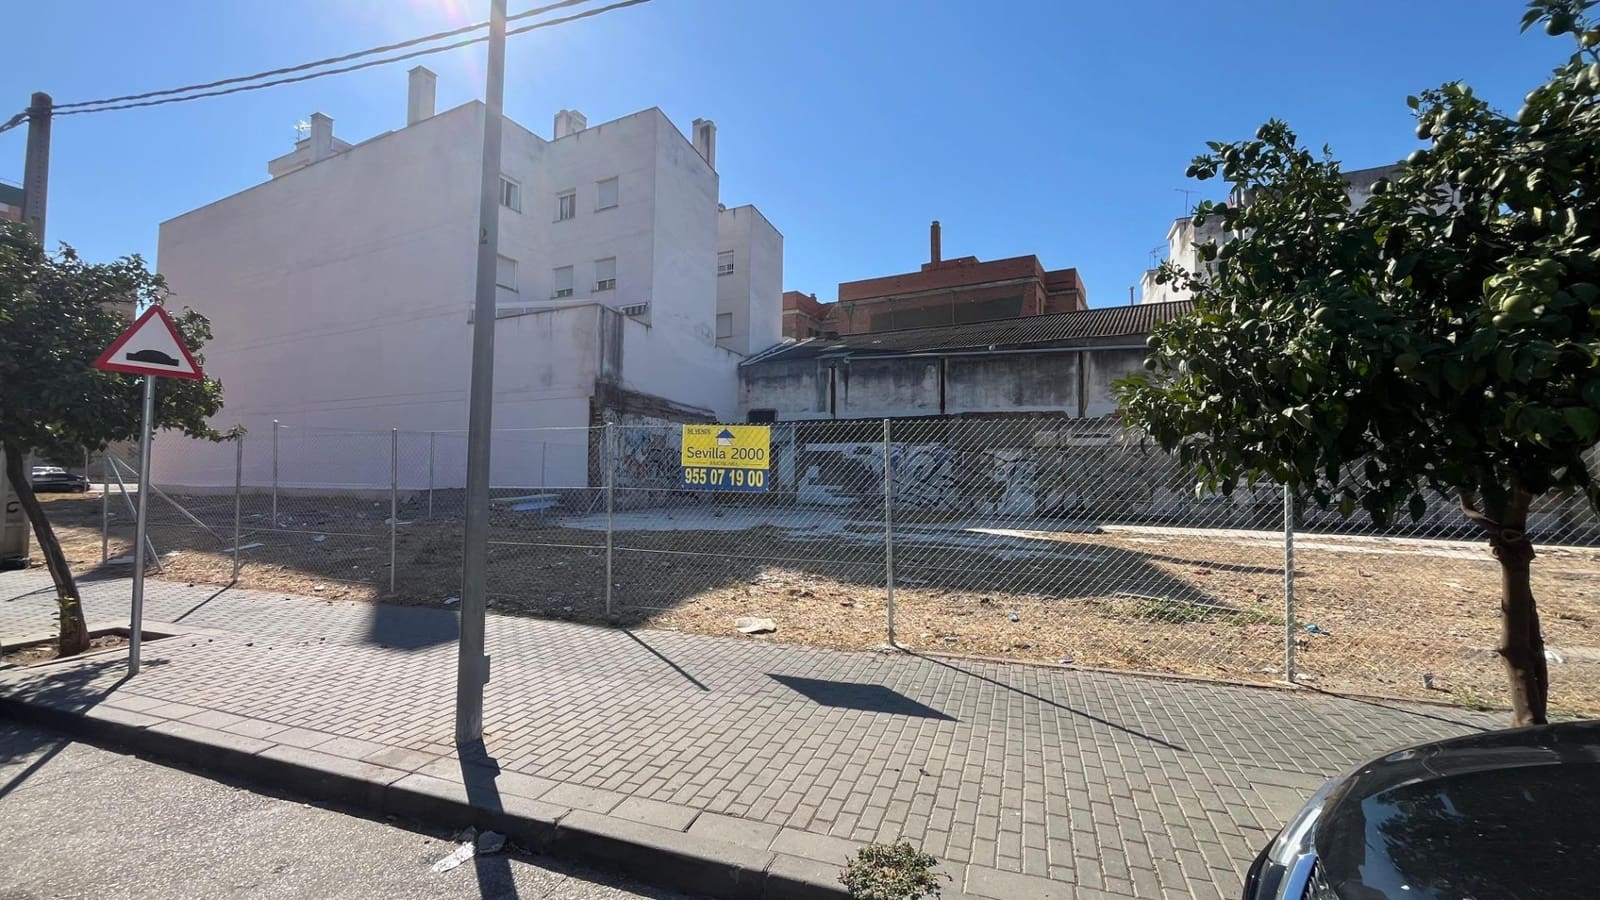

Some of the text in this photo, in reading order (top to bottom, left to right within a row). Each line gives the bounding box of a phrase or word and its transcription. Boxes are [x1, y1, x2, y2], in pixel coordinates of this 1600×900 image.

[687, 446, 765, 460] Sevilla 2000
[685, 468, 764, 487] 955 07 19 00
